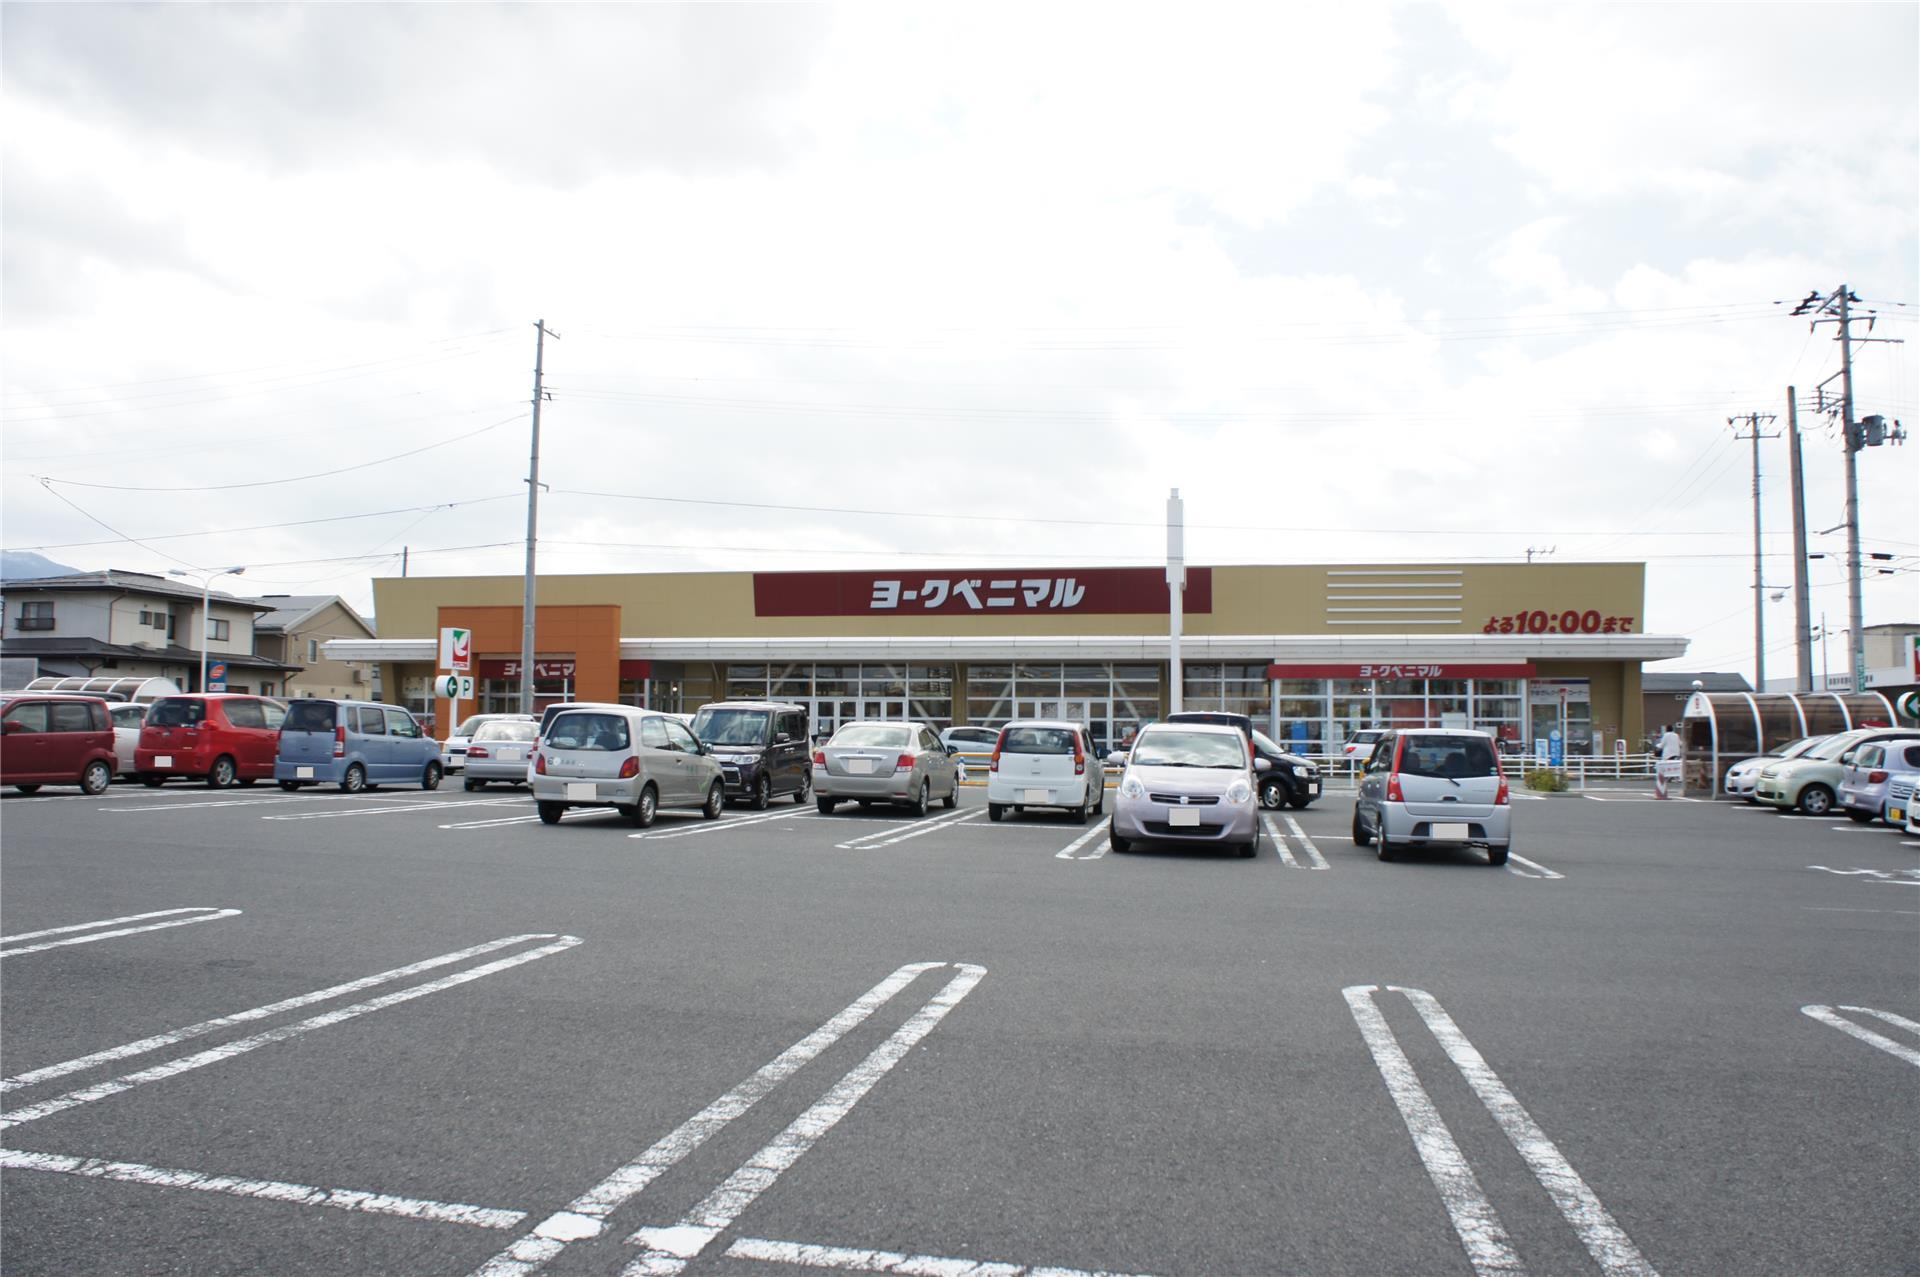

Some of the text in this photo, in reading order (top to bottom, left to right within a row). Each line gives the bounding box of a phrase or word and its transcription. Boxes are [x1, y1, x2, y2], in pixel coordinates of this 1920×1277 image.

[870, 578, 1085, 609] ヨークベニマル
[1483, 610, 1634, 634] よる10:00まで
[503, 662, 576, 677] ヨーベニマ
[1359, 665, 1442, 677] ヨークベニマル
[463, 679, 471, 697] P
